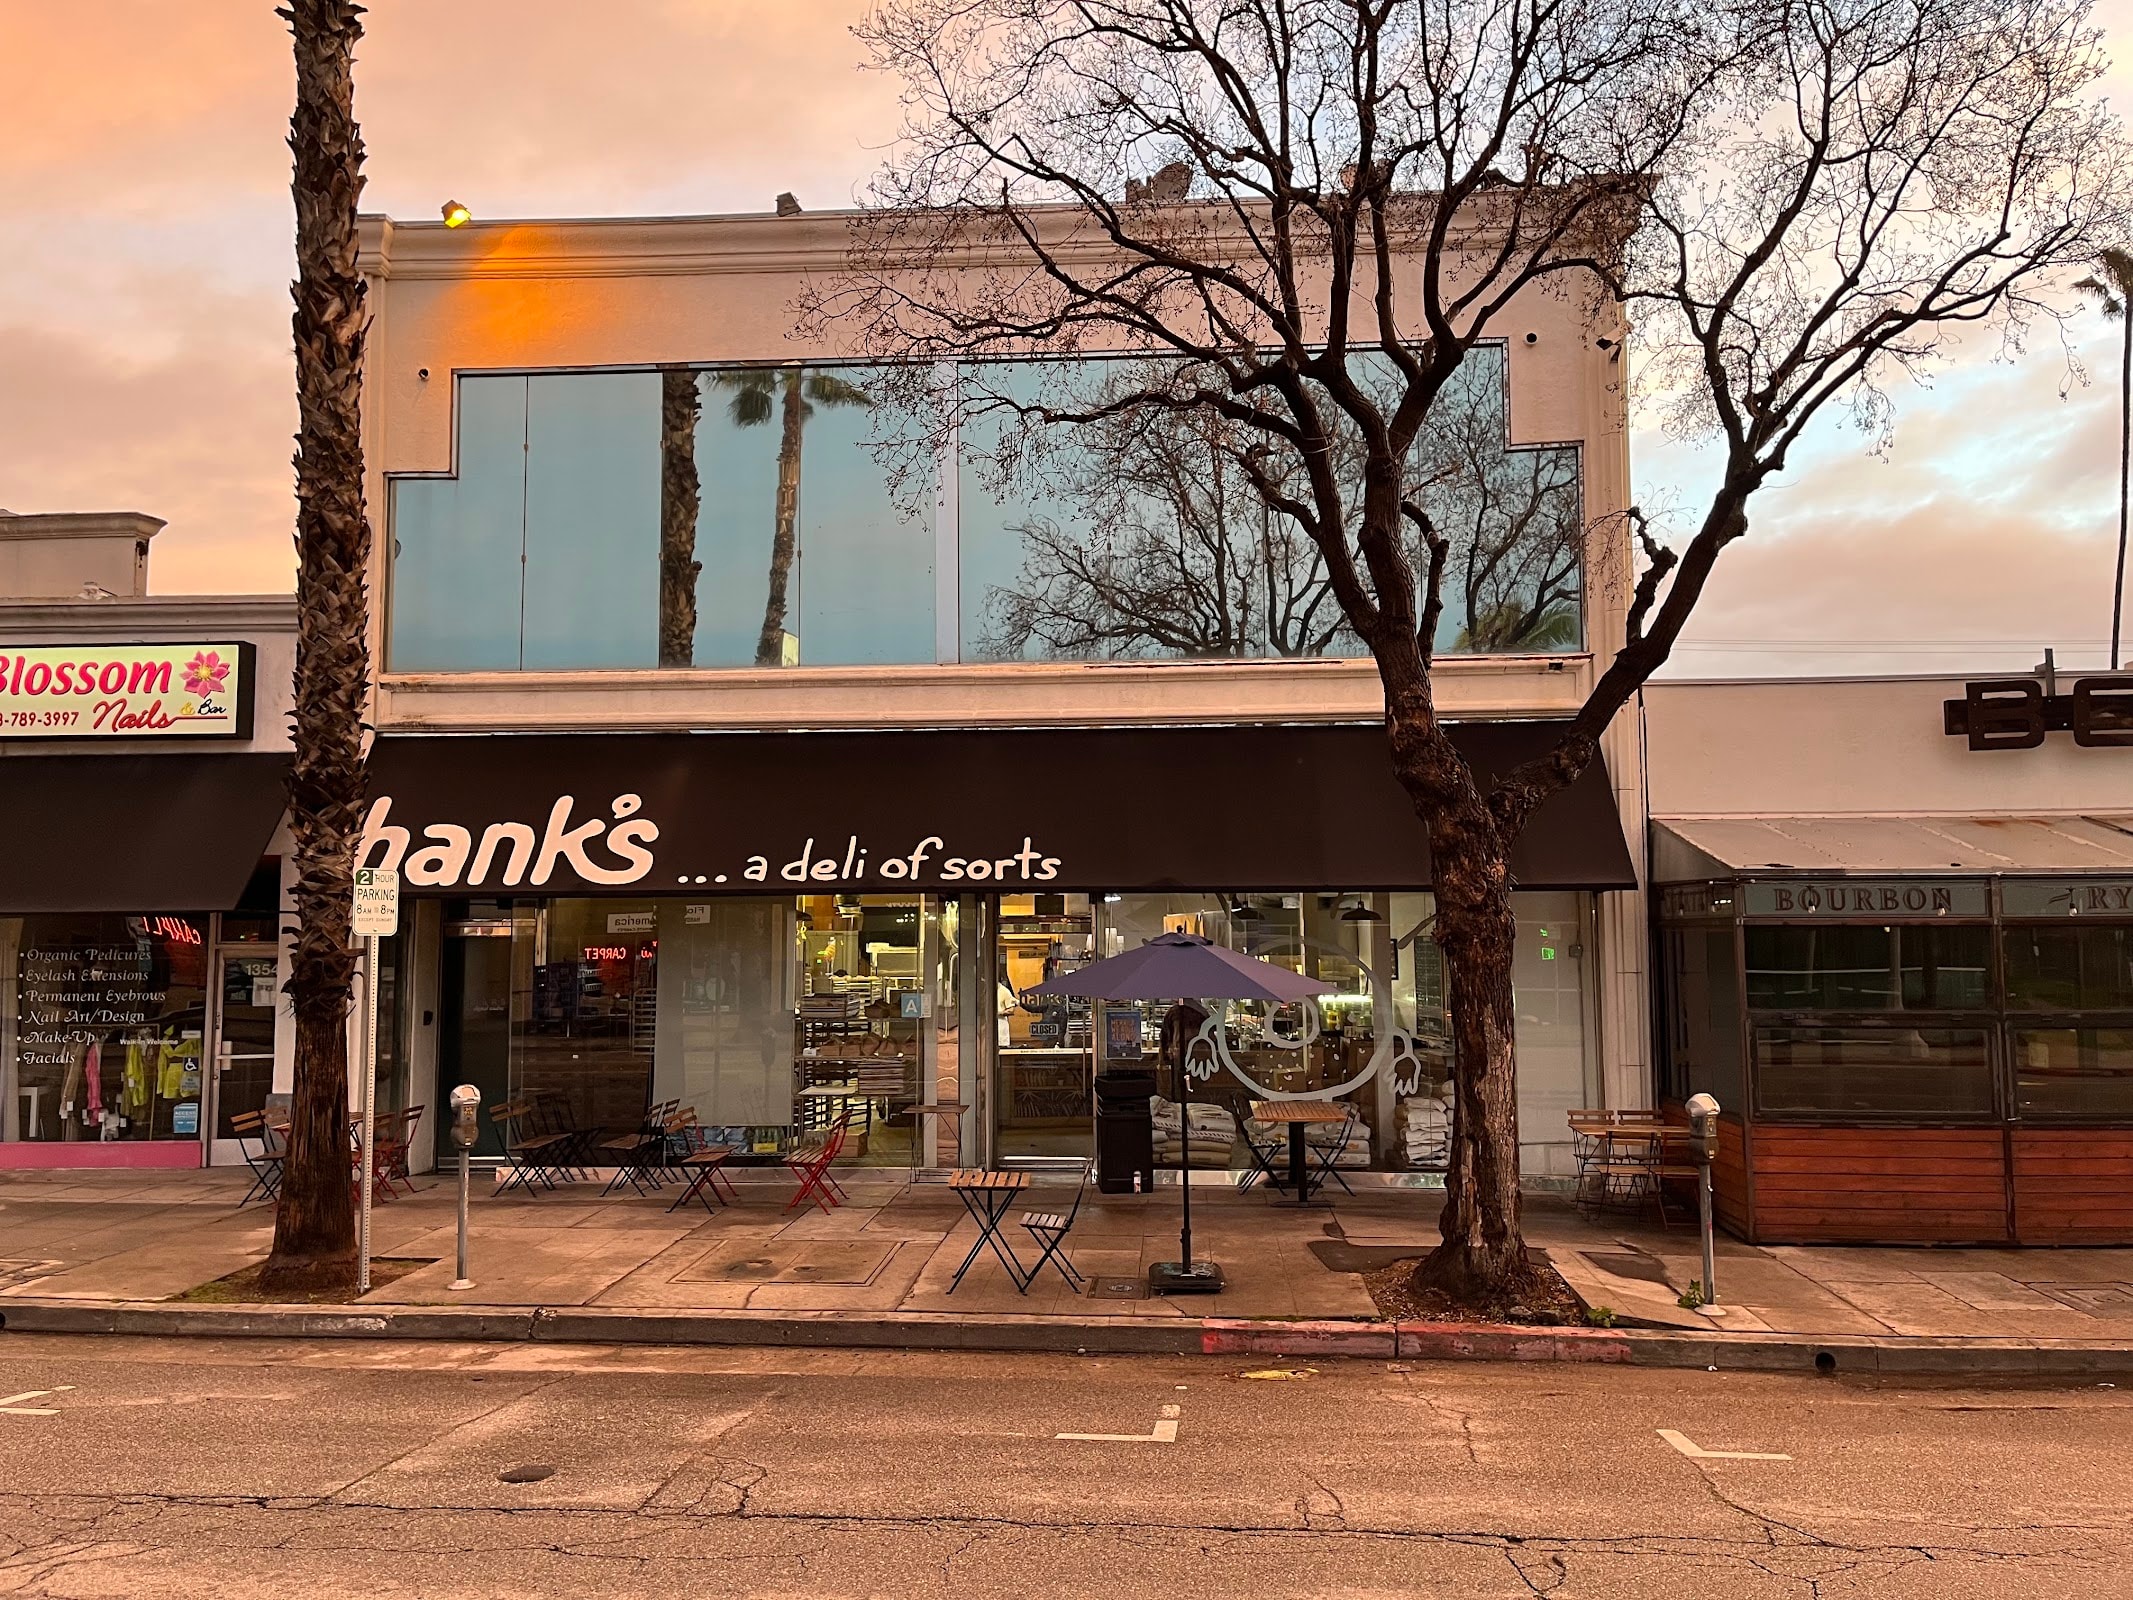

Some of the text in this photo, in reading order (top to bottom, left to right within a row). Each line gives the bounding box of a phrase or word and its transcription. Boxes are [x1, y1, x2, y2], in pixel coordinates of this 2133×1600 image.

[93, 698, 227, 733] Nails & Bar
[353, 793, 660, 887] hank's
[743, 855, 769, 883] a
[780, 835, 868, 883] deli
[879, 836, 944, 881] of
[940, 836, 1062, 882] sorts
[360, 870, 395, 884] 2 HOUR
[357, 888, 395, 901] PARKING
[1774, 887, 1952, 912] BOURBON
[27, 948, 152, 963] Organic Pedicures
[26, 969, 149, 984] Eyelash Extensions
[25, 989, 166, 1004] Permanent Eyebrows
[905, 999, 918, 1013] A
[25, 1008, 145, 1026] Nail Art/Design
[1031, 1024, 1058, 1035] CLOSED
[24, 1030, 96, 1046] Make-Up
[23, 1051, 76, 1065] Facials
